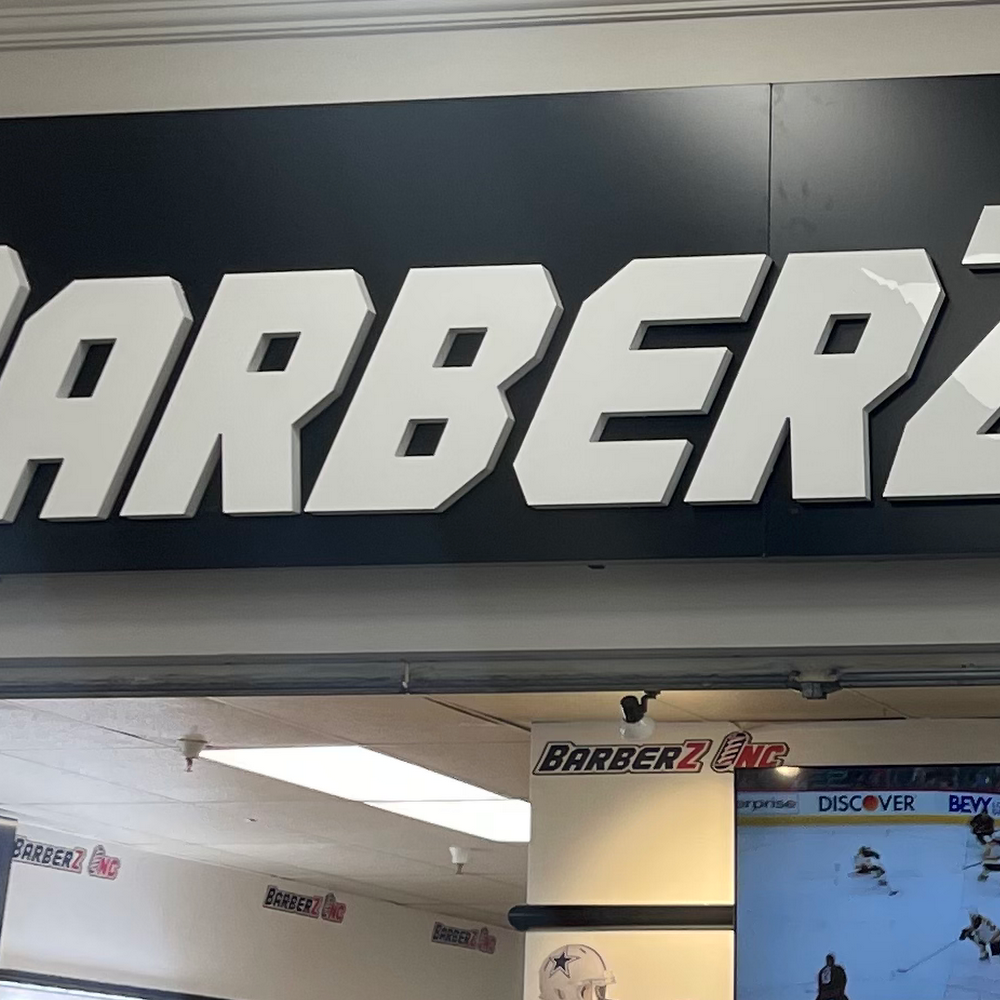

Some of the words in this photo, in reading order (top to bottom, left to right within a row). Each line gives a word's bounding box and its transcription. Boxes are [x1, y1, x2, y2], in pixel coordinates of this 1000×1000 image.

[537, 740, 710, 772] BARBERZ
[818, 794, 917, 812] DISCOVER
[949, 795, 992, 814] BEVY
